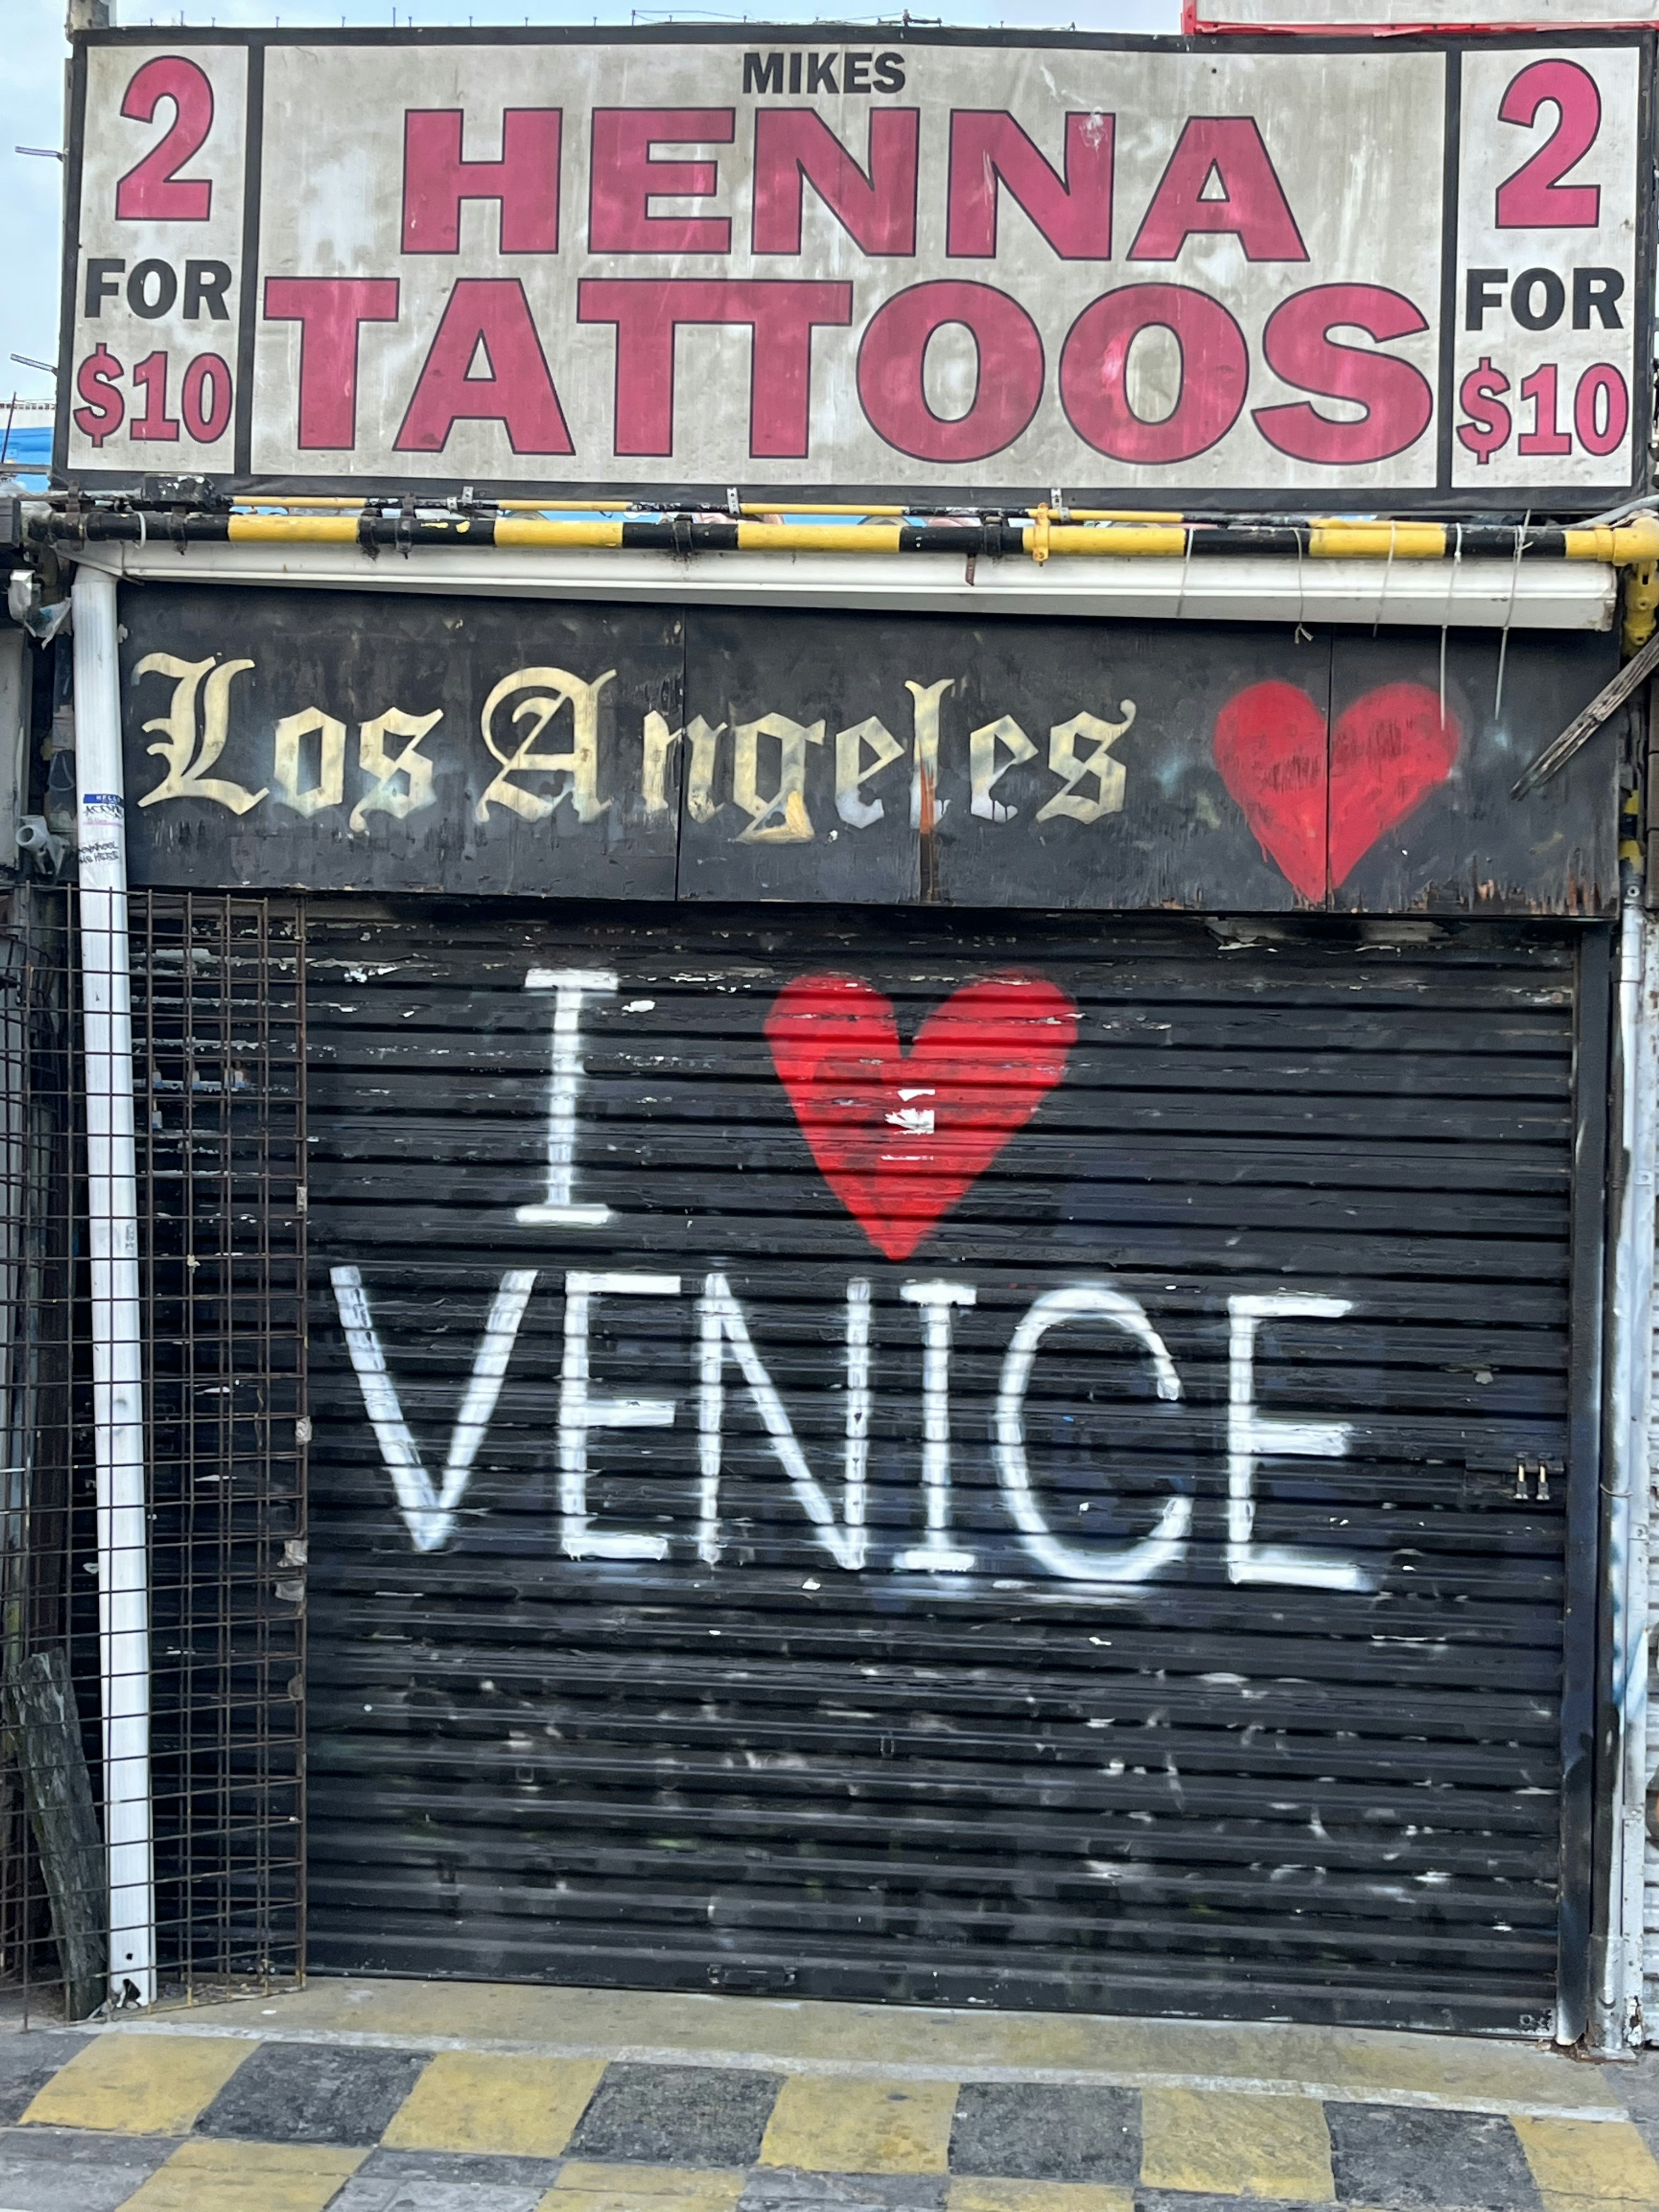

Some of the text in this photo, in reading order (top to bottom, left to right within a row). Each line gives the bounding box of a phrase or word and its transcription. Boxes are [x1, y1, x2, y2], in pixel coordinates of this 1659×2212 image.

[115, 55, 214, 221] 2
[742, 52, 906, 94] MIKES
[1494, 58, 1601, 229] 2
[400, 108, 1310, 262] HENNA
[84, 258, 232, 320] FOR
[1465, 267, 1625, 331] FOR
[73, 343, 233, 448] $10
[263, 276, 1434, 466] TATTOOS
[1455, 357, 1629, 465] $10
[131, 652, 1137, 845] Los Angeles
[515, 968, 619, 1225] I
[330, 1265, 1374, 1592] VENICE
